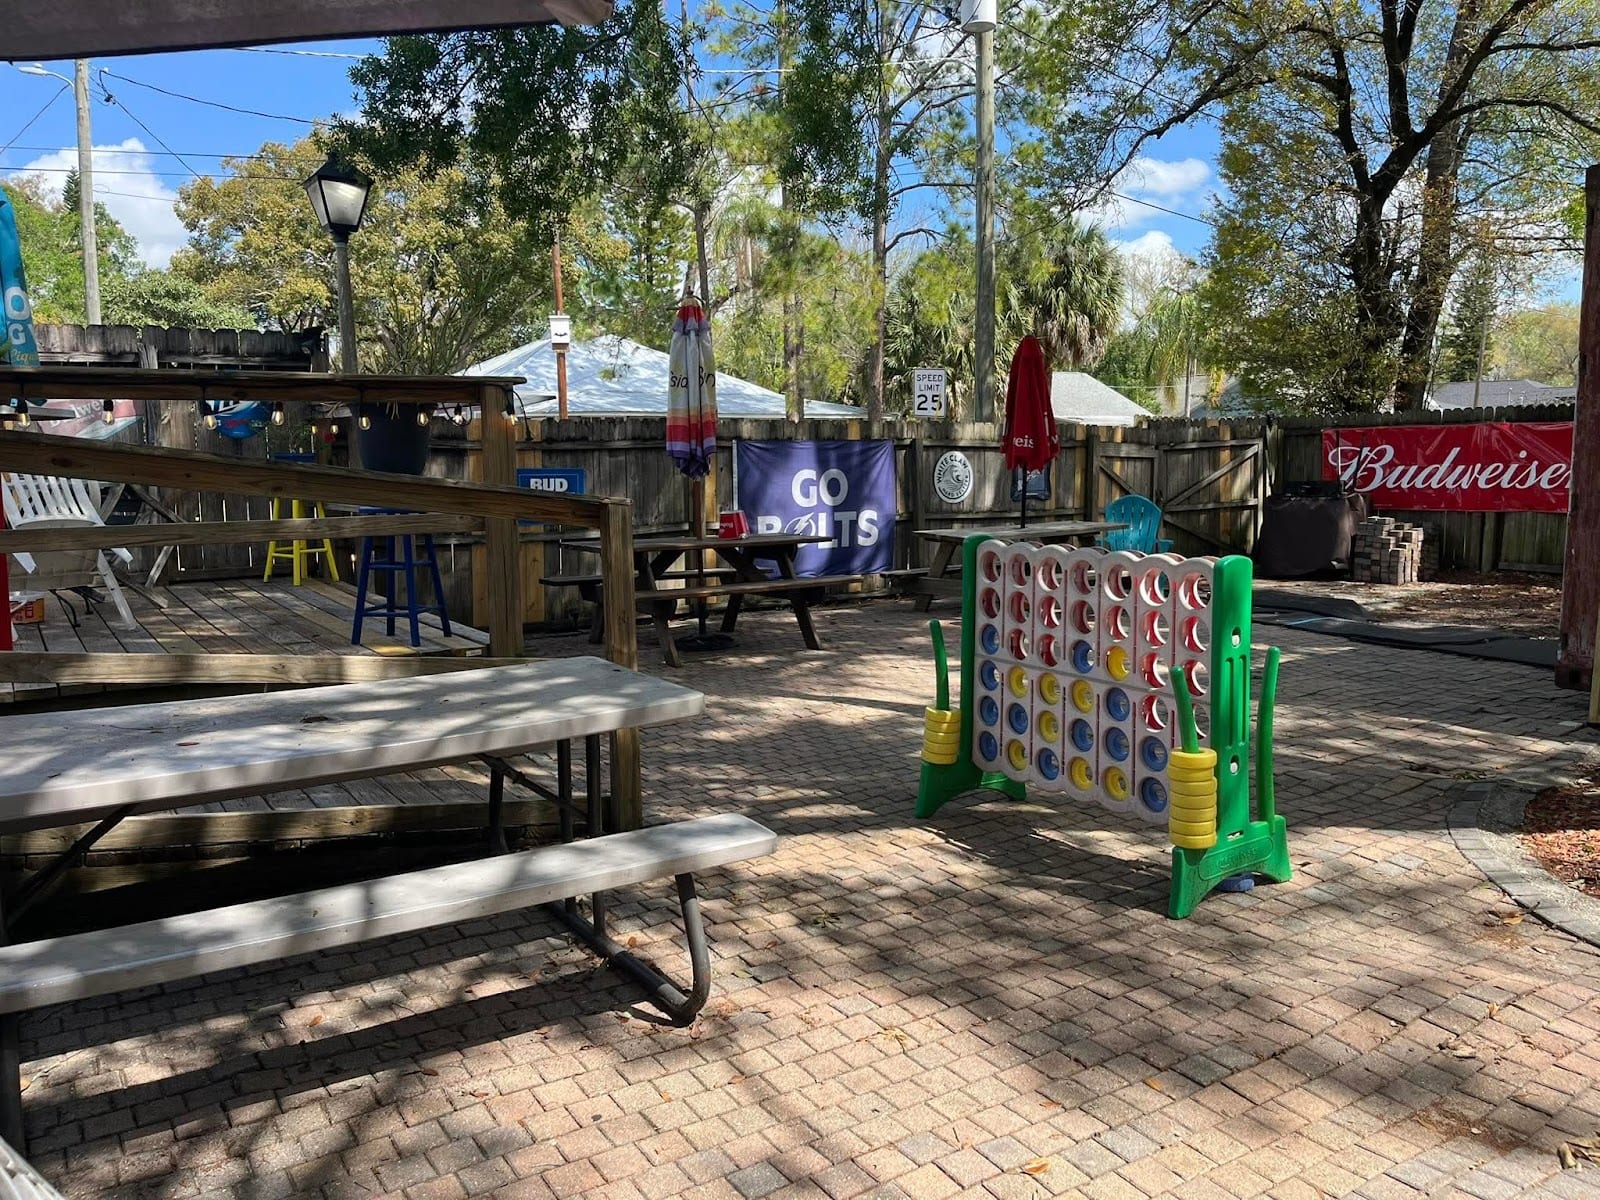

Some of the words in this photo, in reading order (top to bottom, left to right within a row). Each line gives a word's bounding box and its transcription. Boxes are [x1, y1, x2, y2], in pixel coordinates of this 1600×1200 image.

[916, 374, 943, 382] SPEED
[918, 384, 941, 392] LIMIT
[916, 394, 943, 411] 25
[936, 457, 949, 484] WHITE
[949, 454, 969, 469] CLAW
[529, 477, 569, 493] BUD
[791, 468, 849, 508] GO
